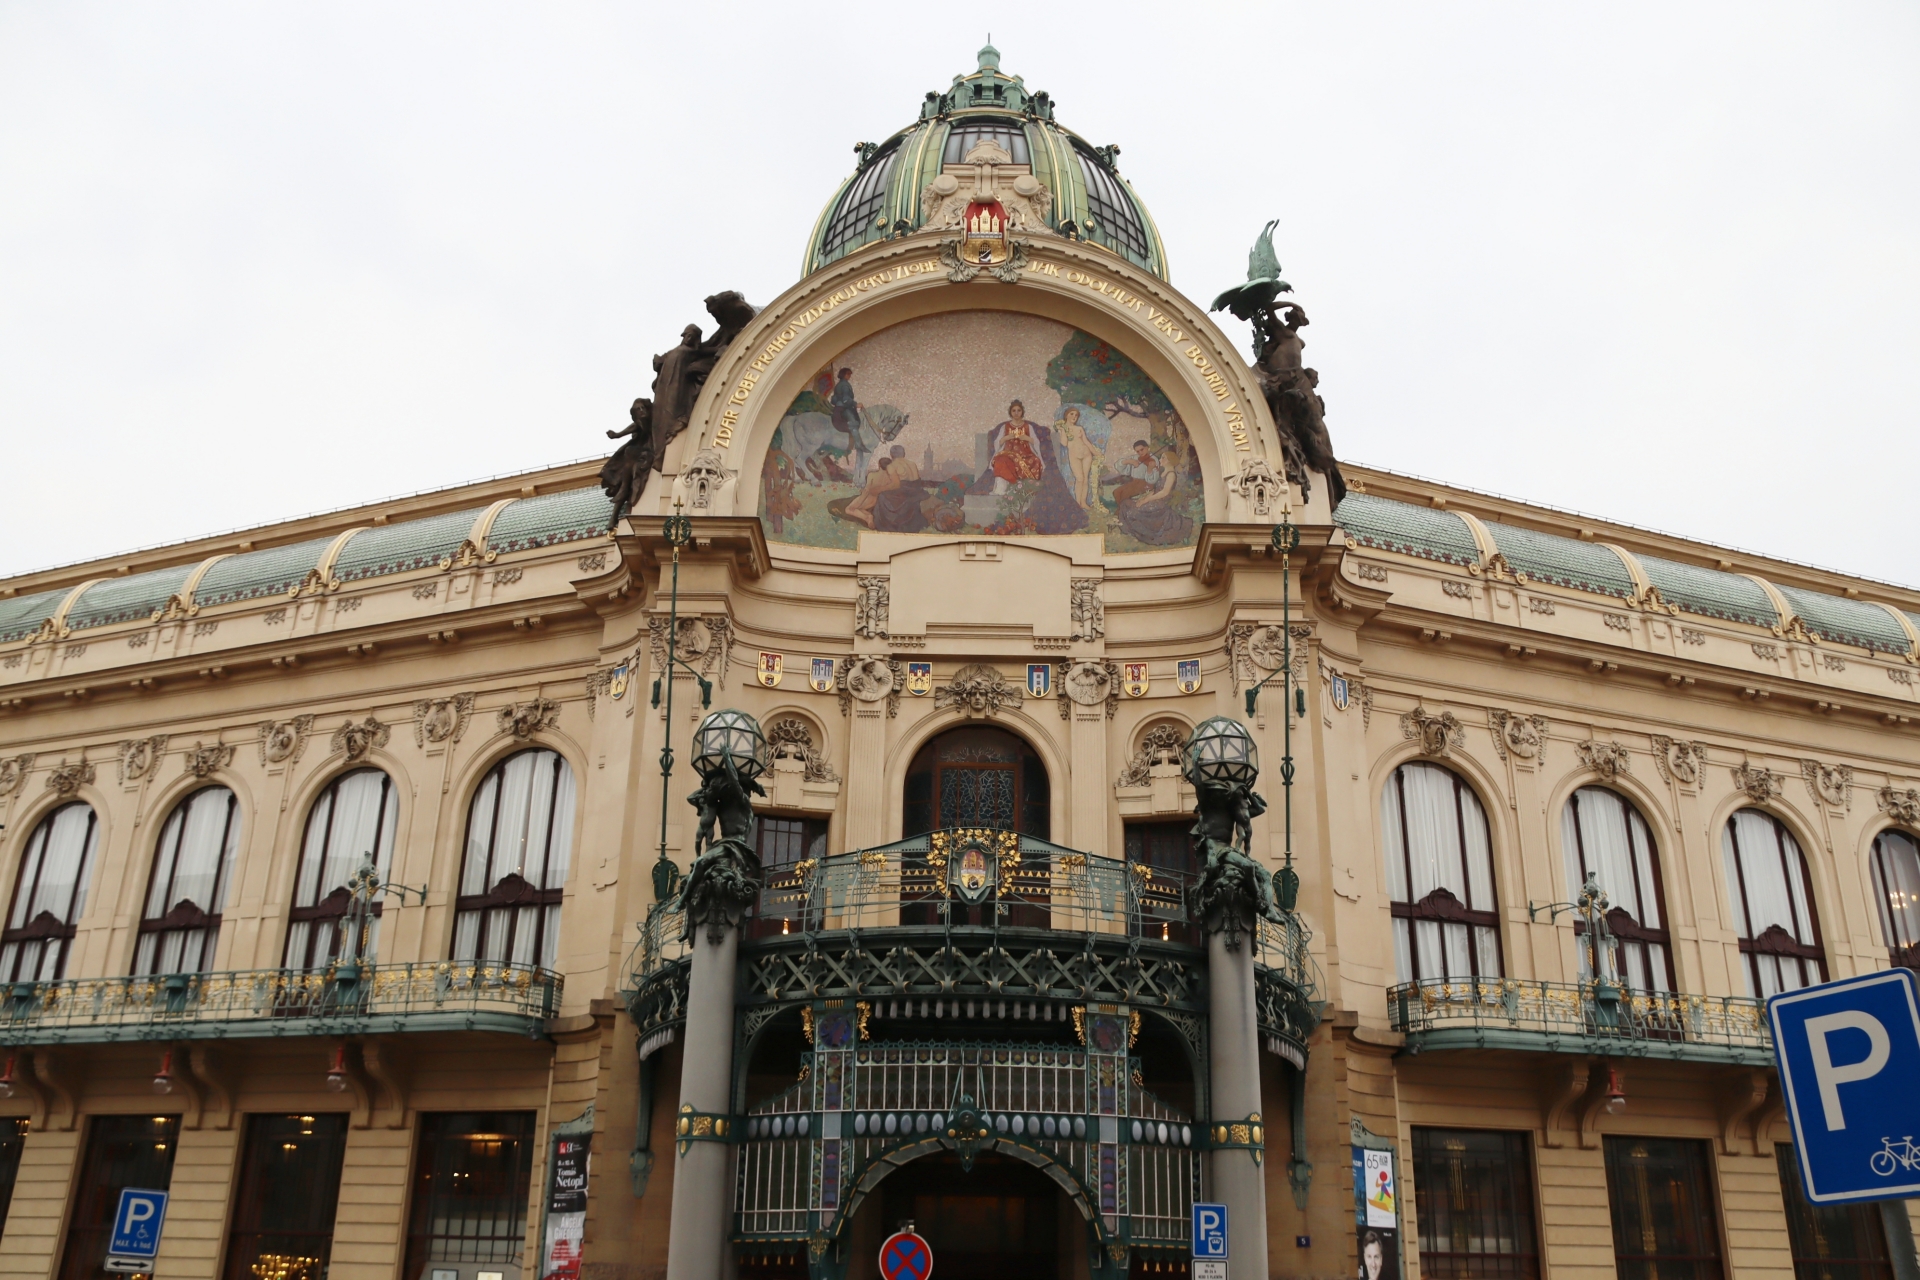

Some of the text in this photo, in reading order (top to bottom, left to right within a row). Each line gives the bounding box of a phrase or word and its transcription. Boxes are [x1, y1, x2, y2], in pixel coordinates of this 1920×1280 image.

[1027, 260, 1063, 278] JAK
[1066, 270, 1145, 312] ODOLALAS
[712, 409, 739, 449] ZDAR
[750, 325, 799, 373] PRAHO!
[790, 284, 858, 328] VZDORUJ
[1804, 1010, 1890, 1132] P
[1367, 1154, 1379, 1169] 65
[123, 1198, 155, 1234] P
[1200, 1211, 1219, 1241] P
